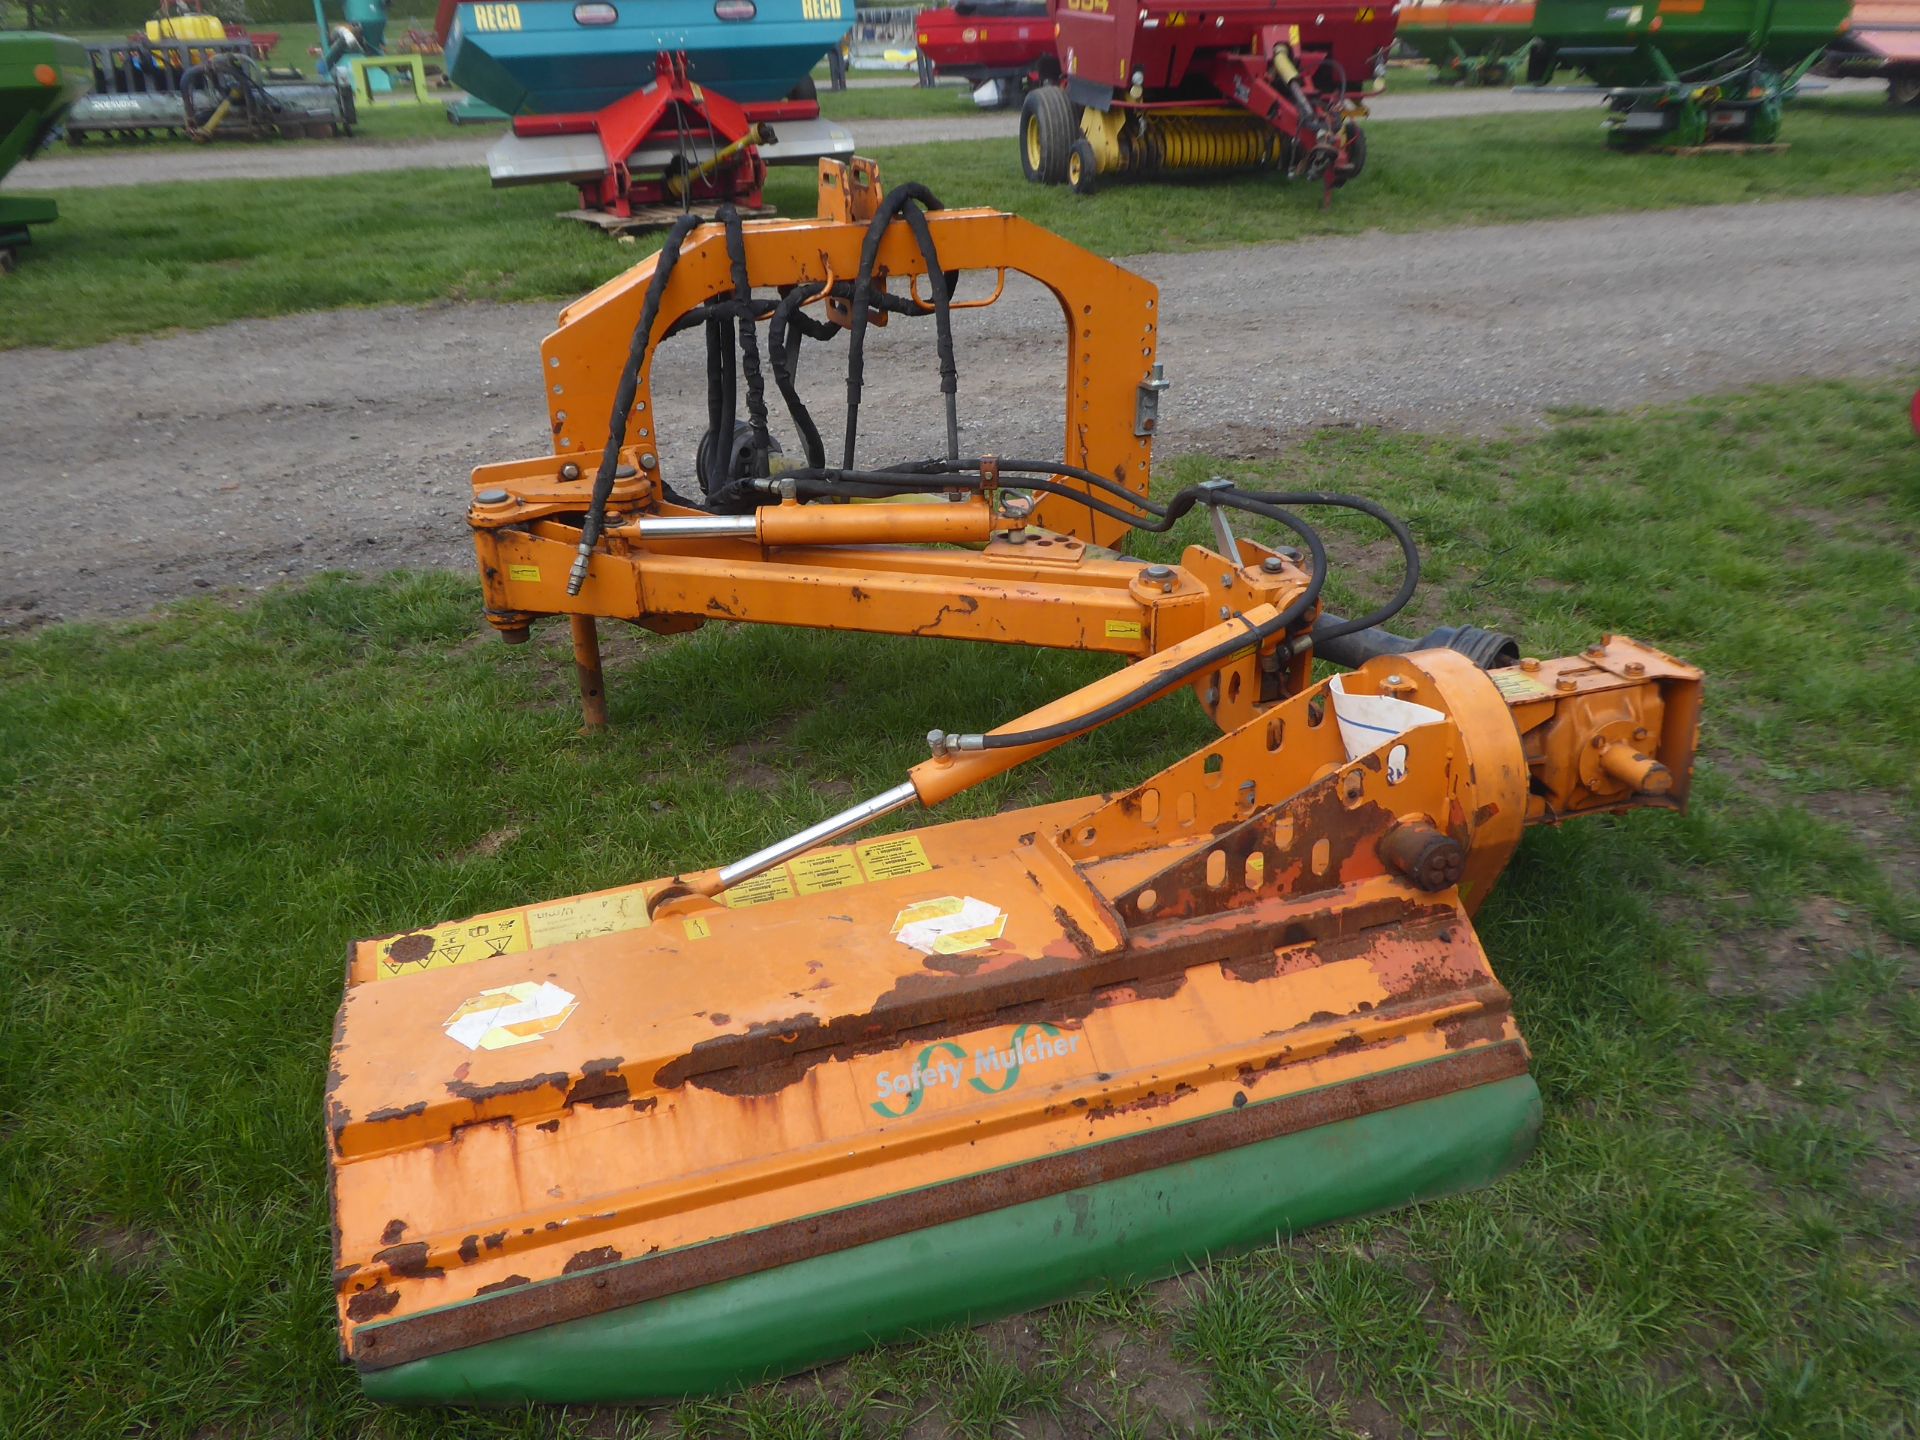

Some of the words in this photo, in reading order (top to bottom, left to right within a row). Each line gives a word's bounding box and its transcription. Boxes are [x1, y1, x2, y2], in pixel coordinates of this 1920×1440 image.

[474, 3, 522, 32] RECO
[875, 1061, 963, 1098] Safety
[975, 1034, 1081, 1075] Mulcher
